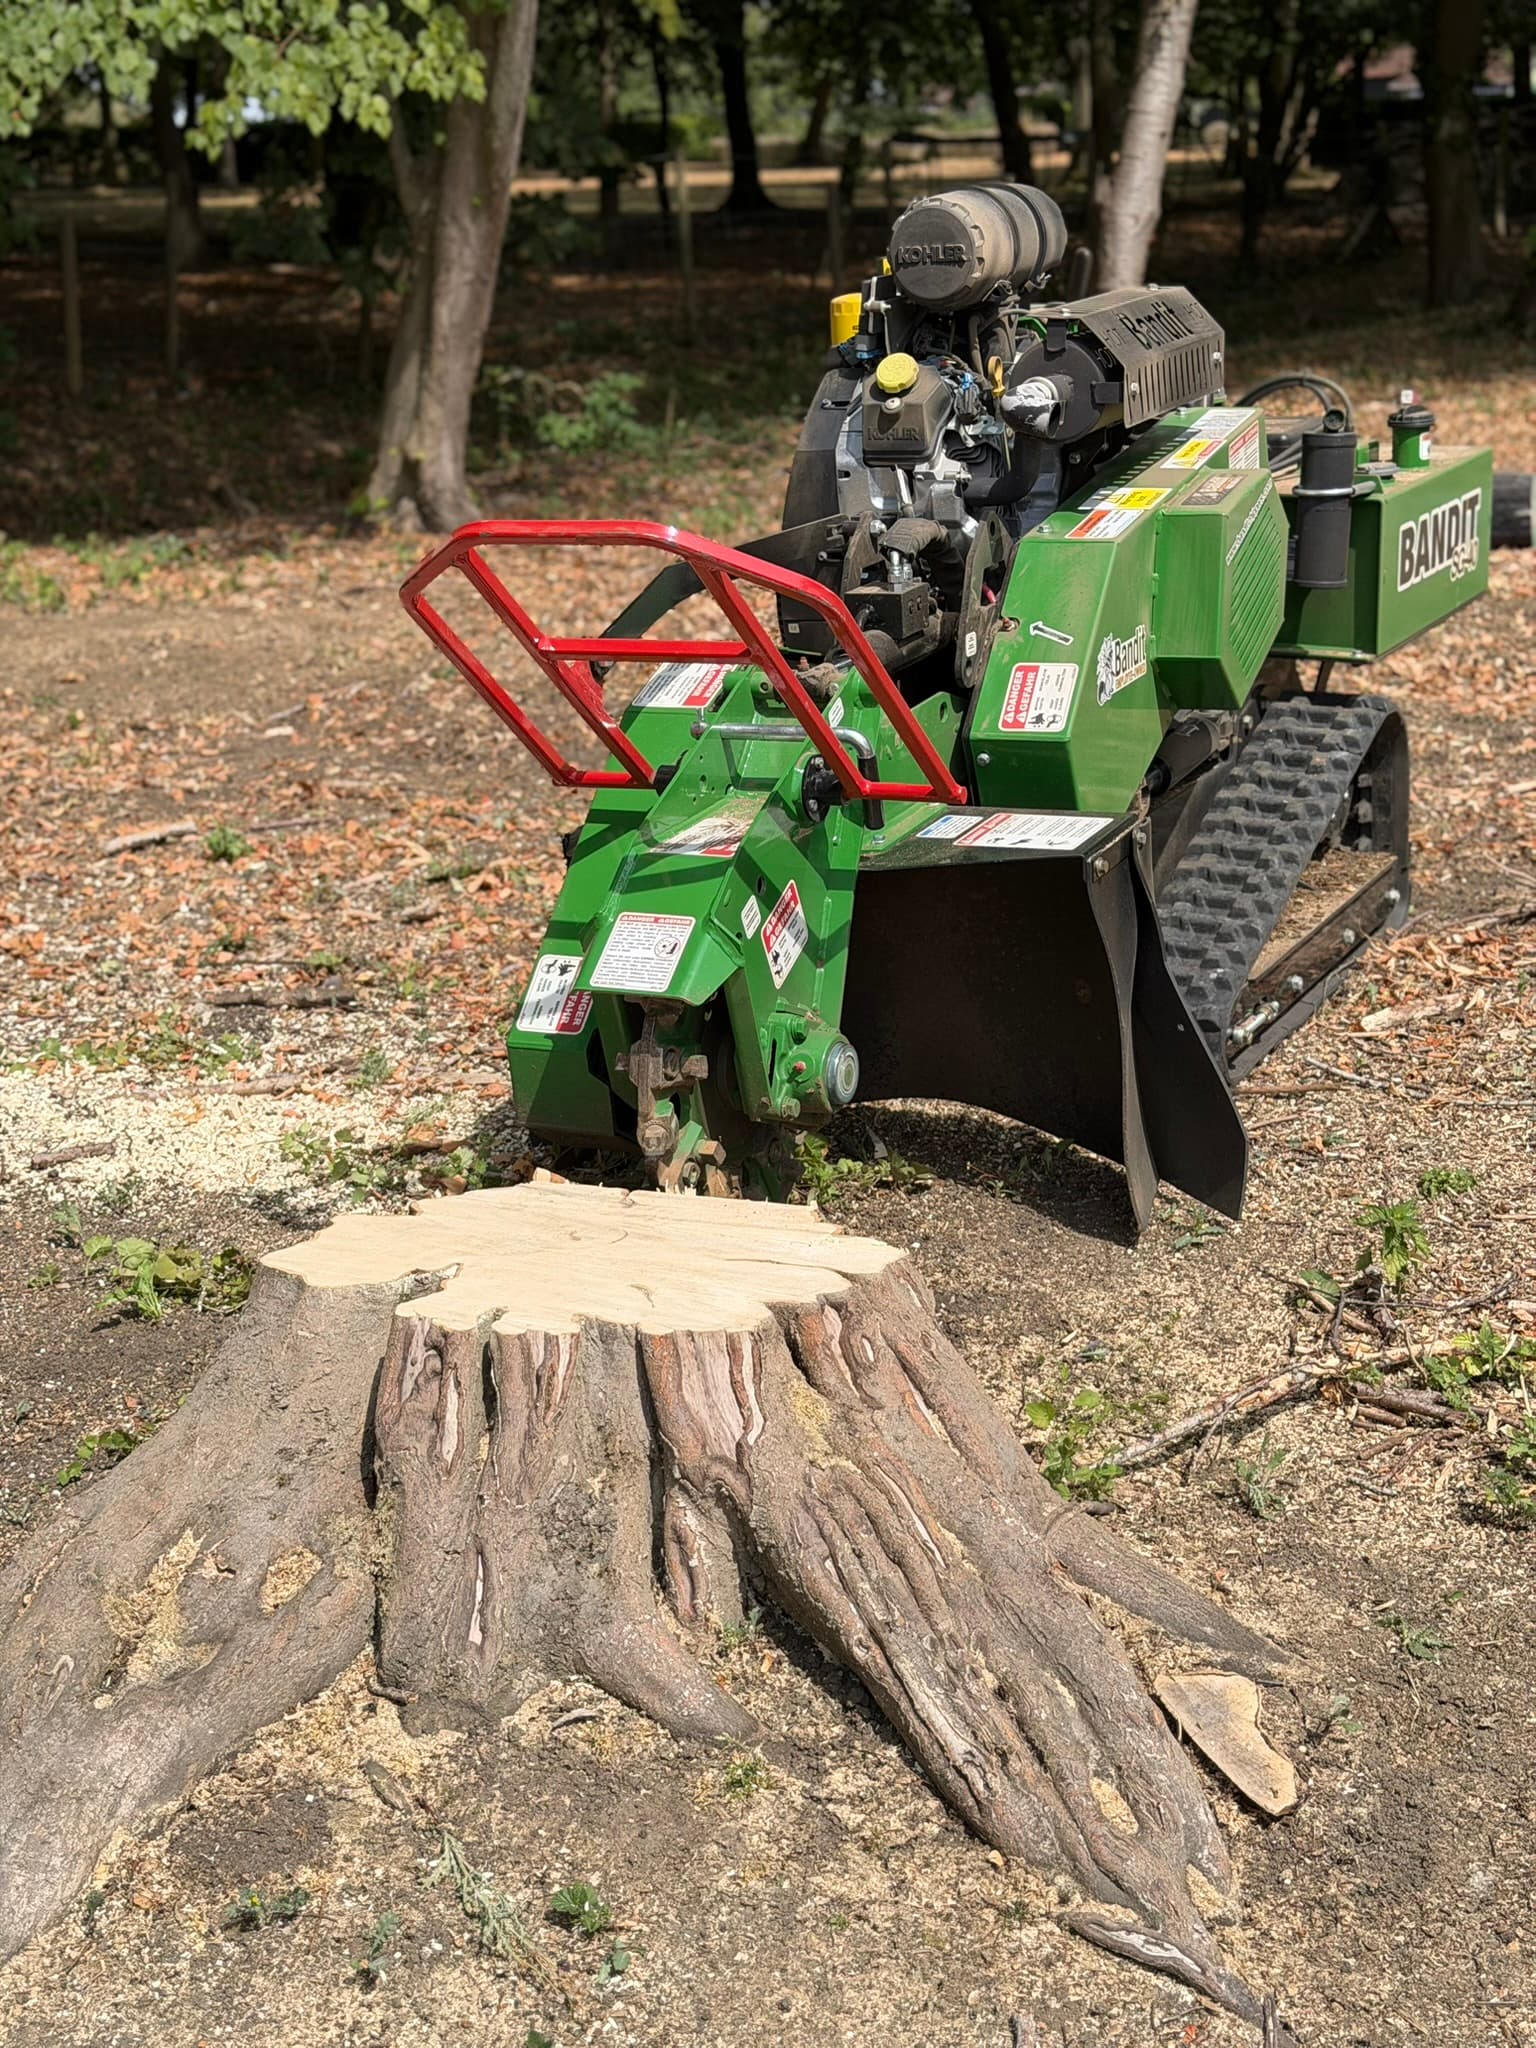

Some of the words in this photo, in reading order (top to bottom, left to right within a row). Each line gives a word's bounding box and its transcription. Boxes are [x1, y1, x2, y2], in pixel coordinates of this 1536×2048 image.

[896, 243, 968, 267] KOHLER
[1117, 300, 1194, 351] Bandit
[1399, 489, 1480, 589] BANDIT
[1112, 625, 1146, 677] Bandit
[1007, 670, 1024, 711] DANGER
[1019, 671, 1036, 711] GEFAHR
